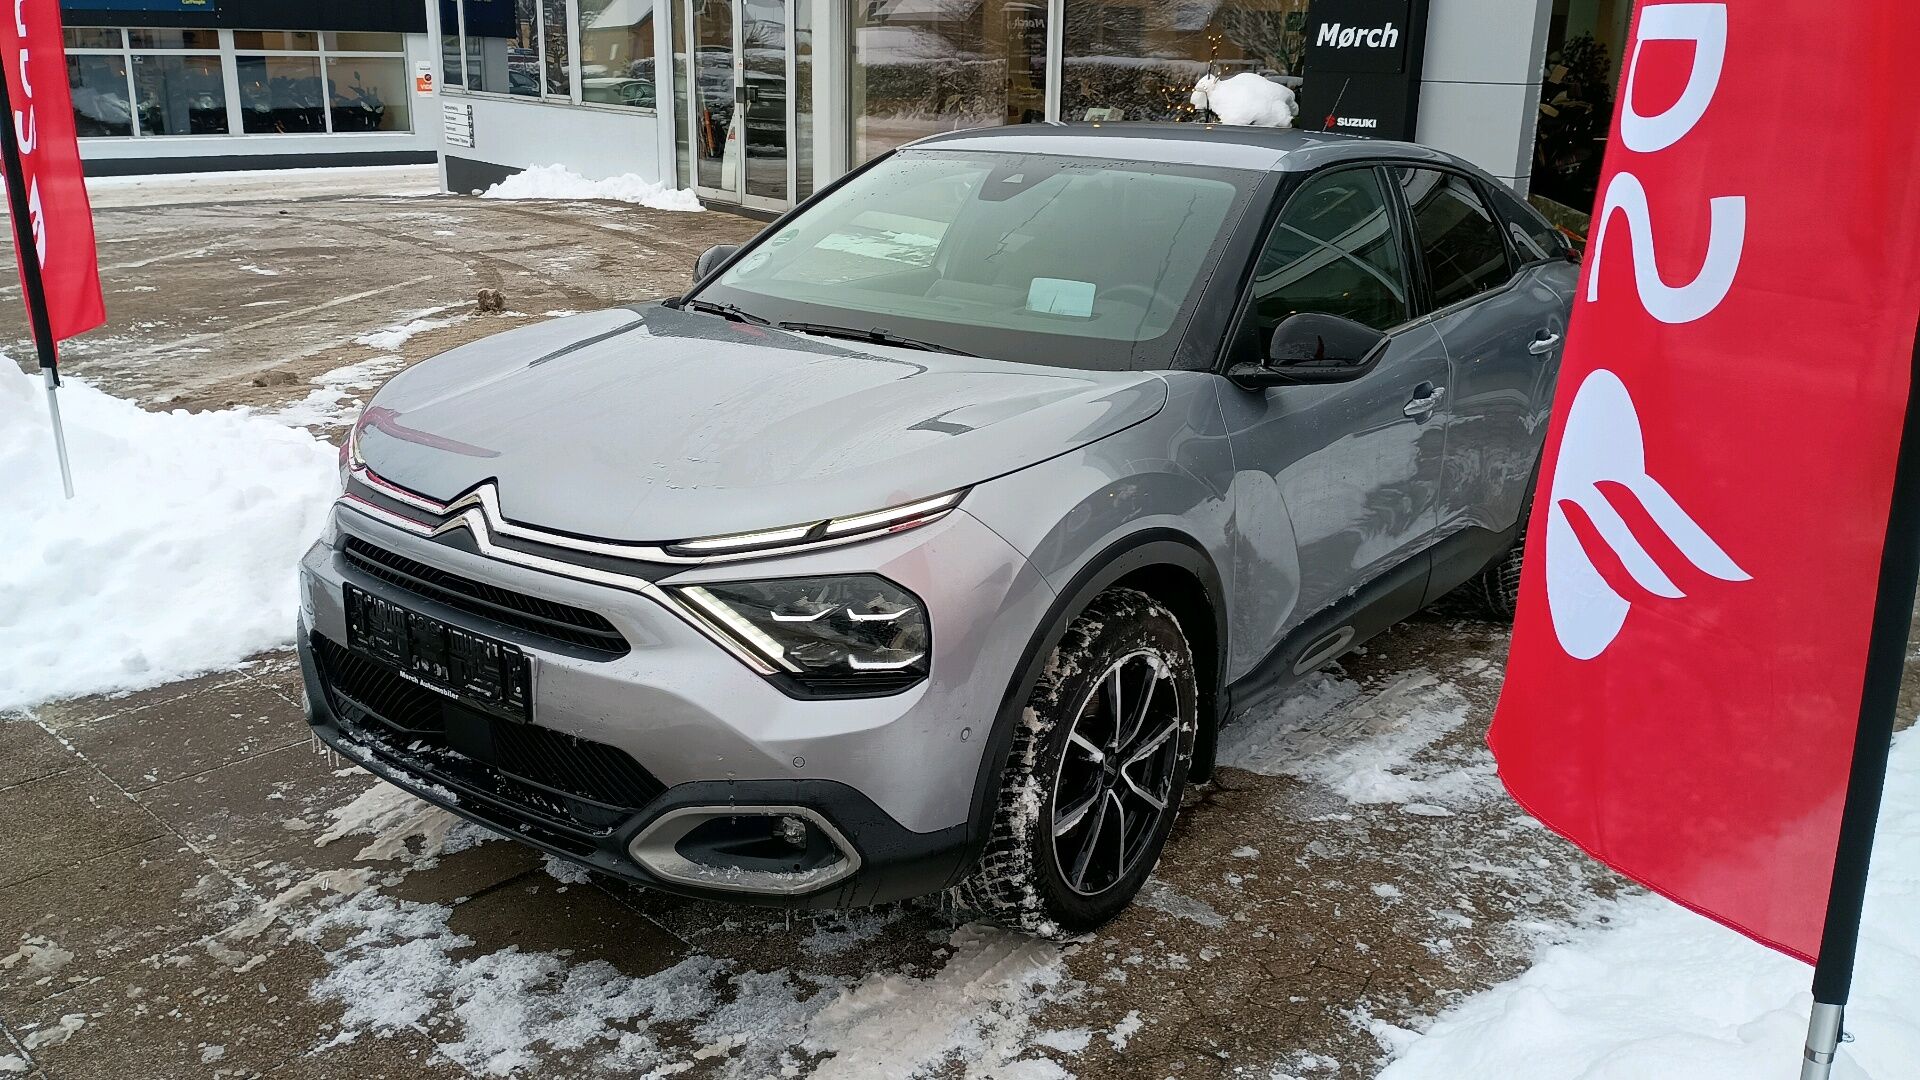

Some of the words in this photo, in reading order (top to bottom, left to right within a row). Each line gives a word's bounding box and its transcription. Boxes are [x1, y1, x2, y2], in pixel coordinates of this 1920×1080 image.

[1316, 22, 1399, 50] Mørch
[1336, 117, 1377, 128] SUZUKI
[419, 679, 459, 700] Automobiler
